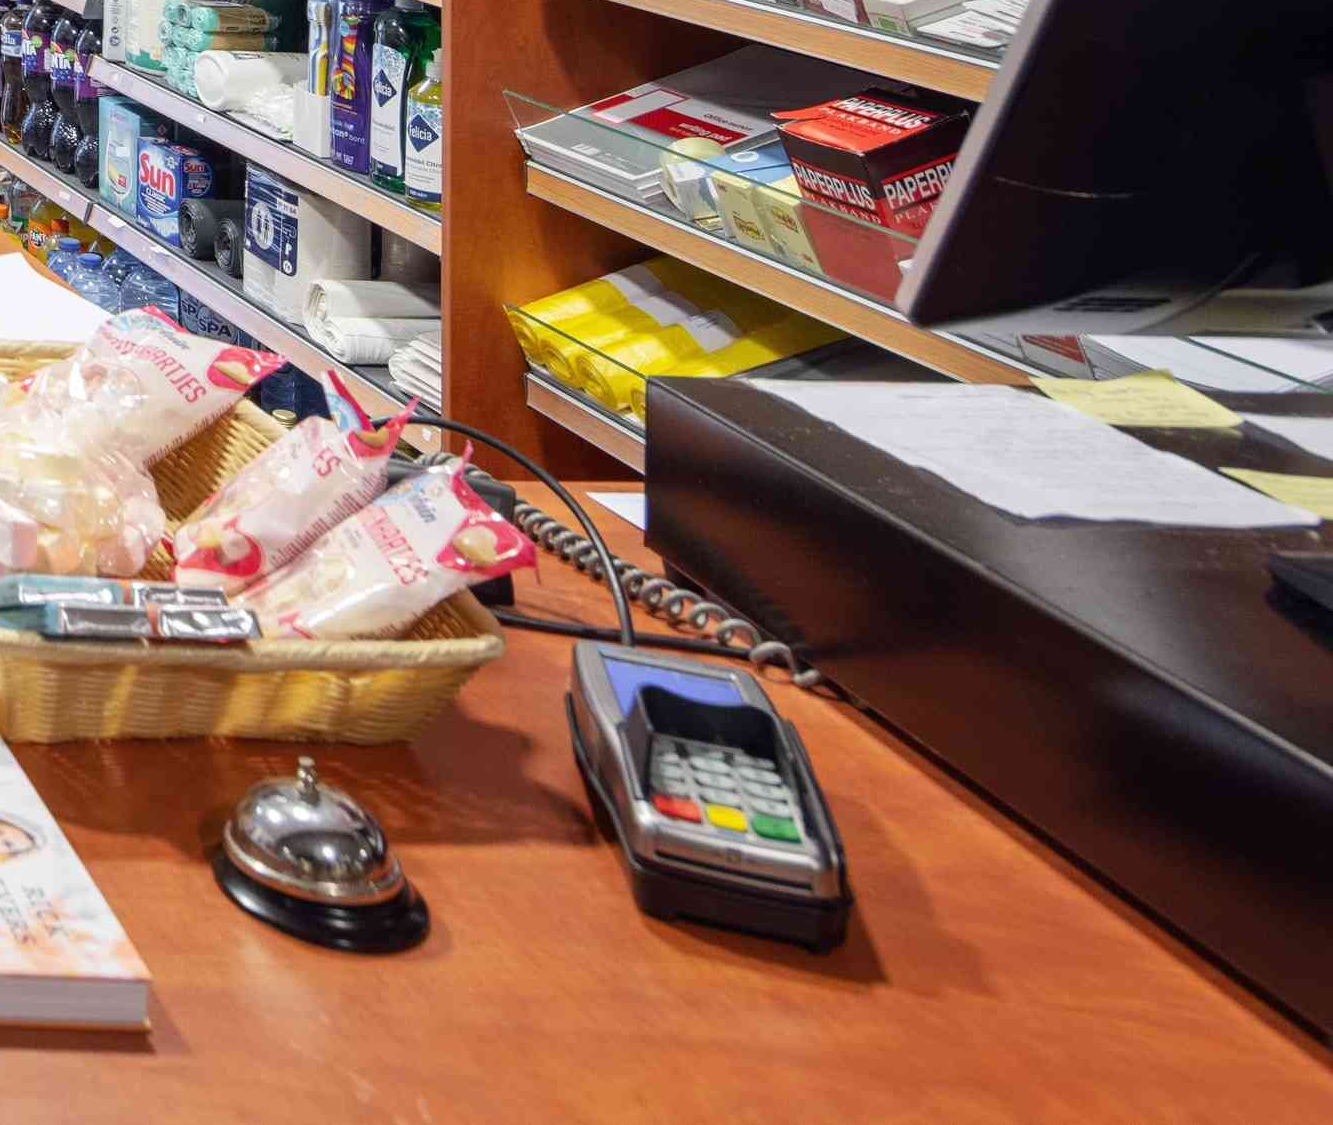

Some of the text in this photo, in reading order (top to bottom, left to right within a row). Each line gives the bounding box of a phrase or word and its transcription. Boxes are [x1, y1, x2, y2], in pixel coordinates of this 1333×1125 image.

[834, 96, 931, 129] PAPERPLUS
[139, 153, 175, 198] Sun
[183, 160, 206, 173] Sun
[792, 161, 877, 211] PAPERPLUS
[28, 229, 48, 248] FANT
[198, 318, 231, 338] SPA
